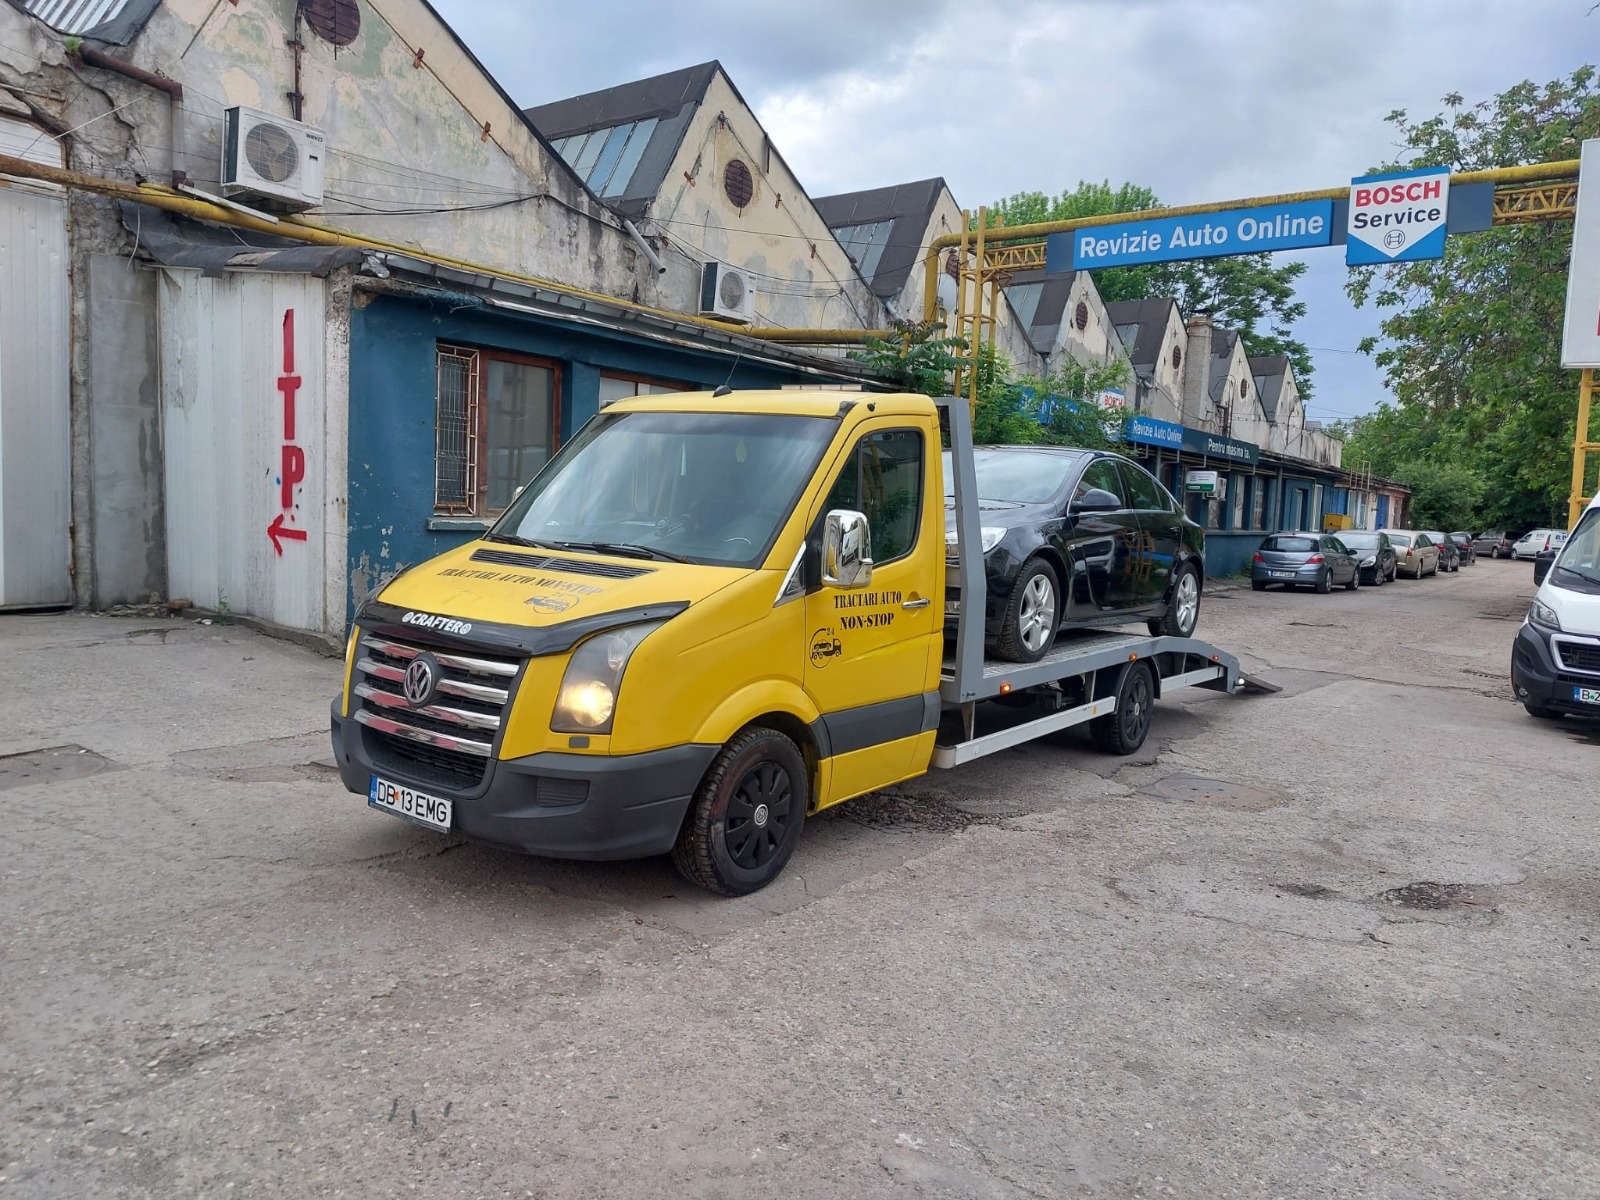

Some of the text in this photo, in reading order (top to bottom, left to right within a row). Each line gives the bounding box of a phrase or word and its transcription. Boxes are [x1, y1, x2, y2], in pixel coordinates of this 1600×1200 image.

[1355, 180, 1441, 207] BOSCH
[1353, 206, 1441, 230] Service
[1079, 213, 1325, 259] Revizie Auto Online
[1133, 420, 1182, 443] Revizie Auto Online
[1207, 438, 1226, 453] Pentru
[437, 568, 499, 580] TRACTARI
[495, 573, 536, 585] AUTO
[833, 591, 902, 608] TRACTARI AUTO
[409, 612, 465, 634] CRAFTER
[840, 613, 894, 630] NON-STOP
[1581, 689, 1590, 700] B
[377, 781, 447, 823] DB 13 EMG
